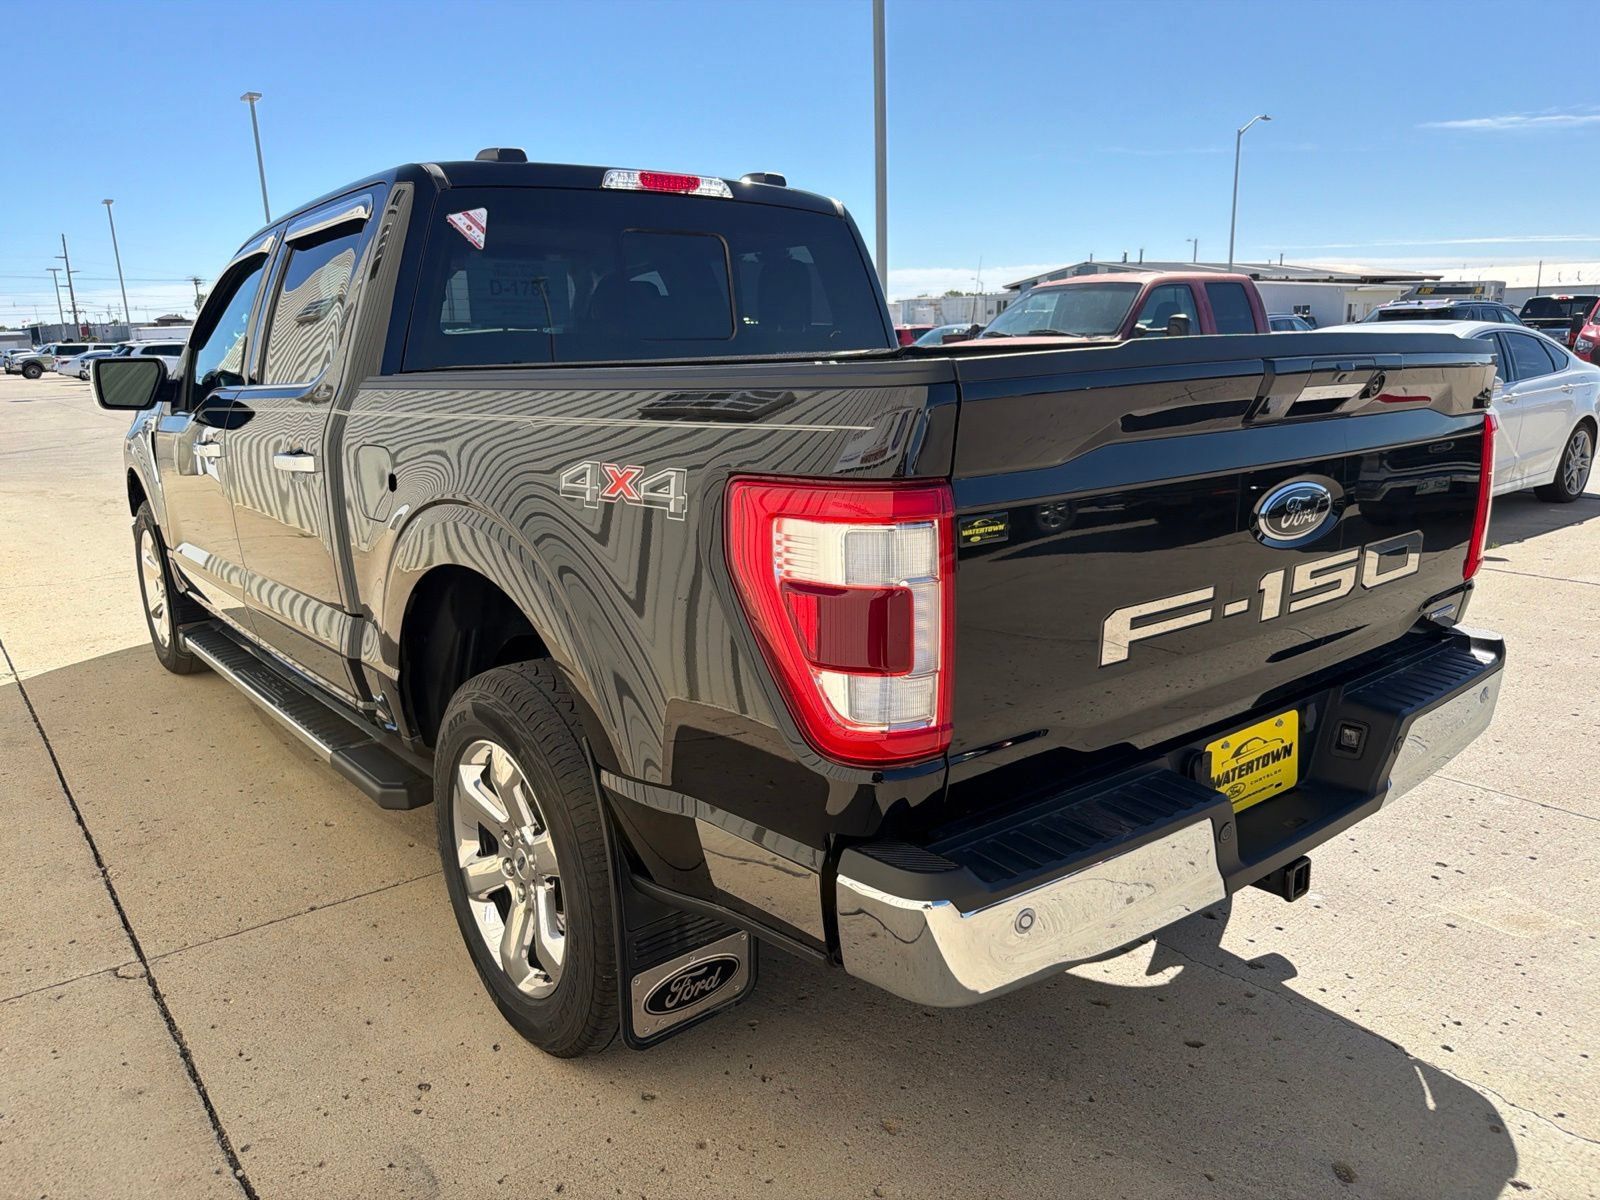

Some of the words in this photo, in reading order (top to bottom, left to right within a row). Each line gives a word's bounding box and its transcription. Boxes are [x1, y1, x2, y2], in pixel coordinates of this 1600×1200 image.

[962, 524, 1005, 536] WATERTOWN
[1281, 494, 1324, 529] Ford
[1099, 529, 1424, 668] F-150
[1212, 743, 1293, 789] WATERTOWN
[664, 966, 723, 1009] Ford
